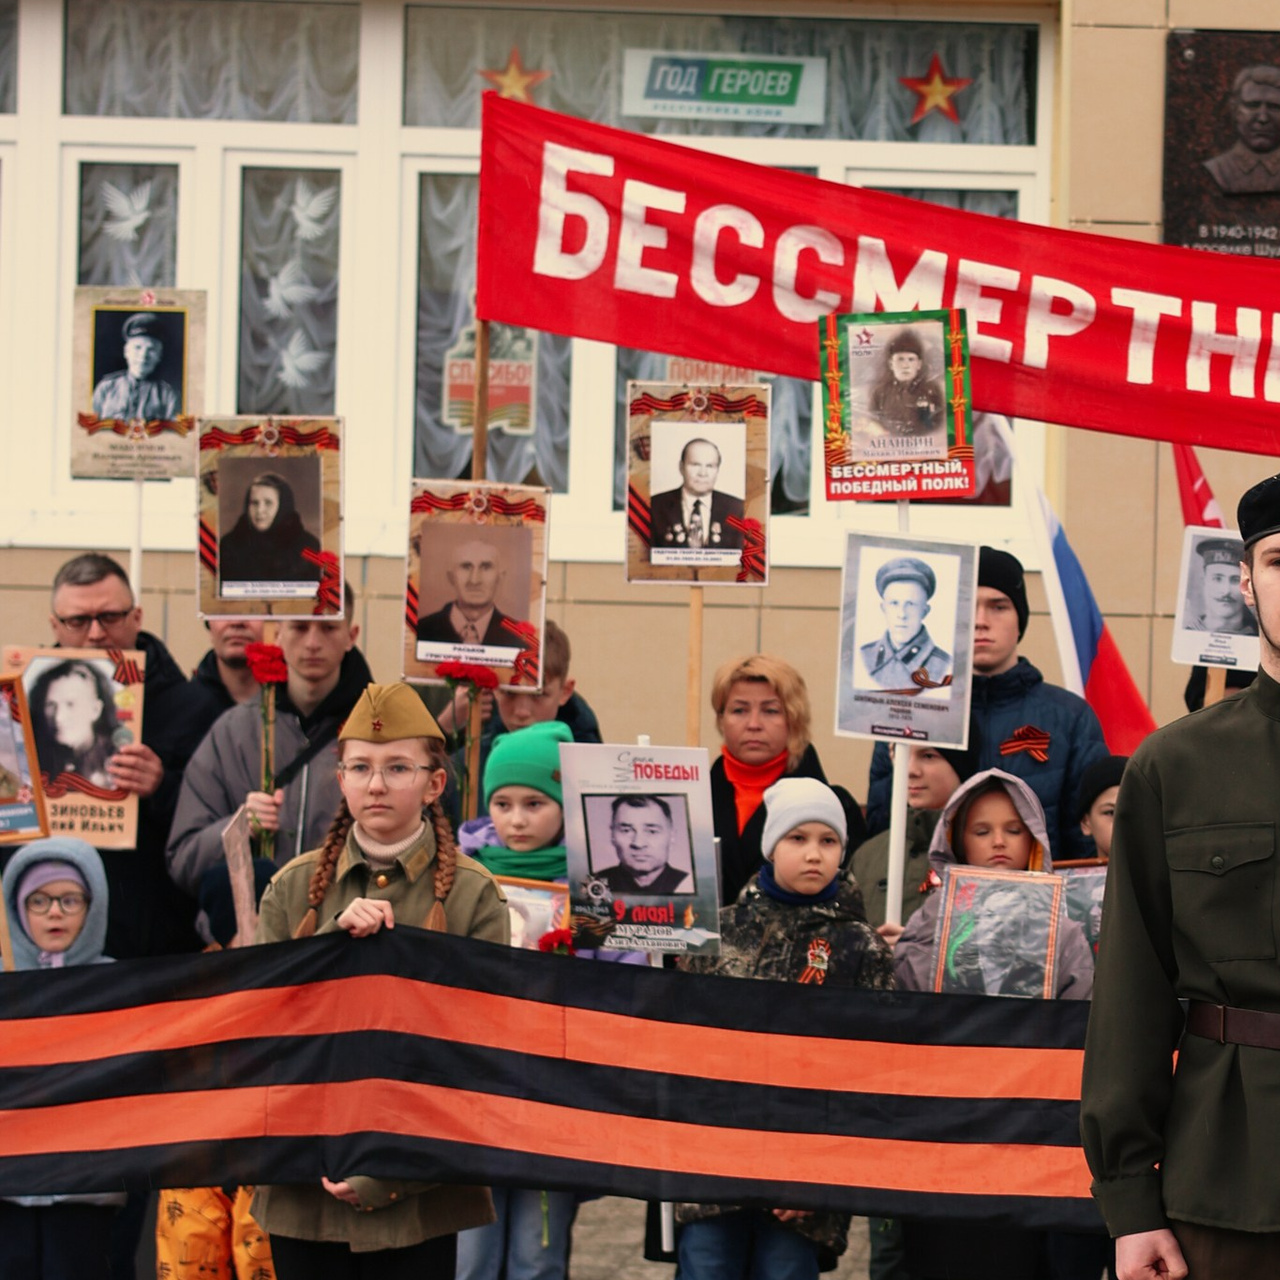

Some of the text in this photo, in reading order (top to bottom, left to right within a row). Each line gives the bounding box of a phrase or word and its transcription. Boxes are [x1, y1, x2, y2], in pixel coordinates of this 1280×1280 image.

[653, 65, 793, 97] ГОД ГЕРОЕВ
[1212, 225, 1279, 240] 1940-1942
[448, 362, 532, 384] СПСИБО!
[831, 459, 968, 479] БЕССМЕРТНЫЙ,
[830, 477, 970, 495] ПОБЕДНЫЙ ПОЛК!
[51, 803, 125, 819] ЗИНОВЬЕВ
[81, 821, 124, 833] Ильич
[613, 899, 675, 924] 9 мая!
